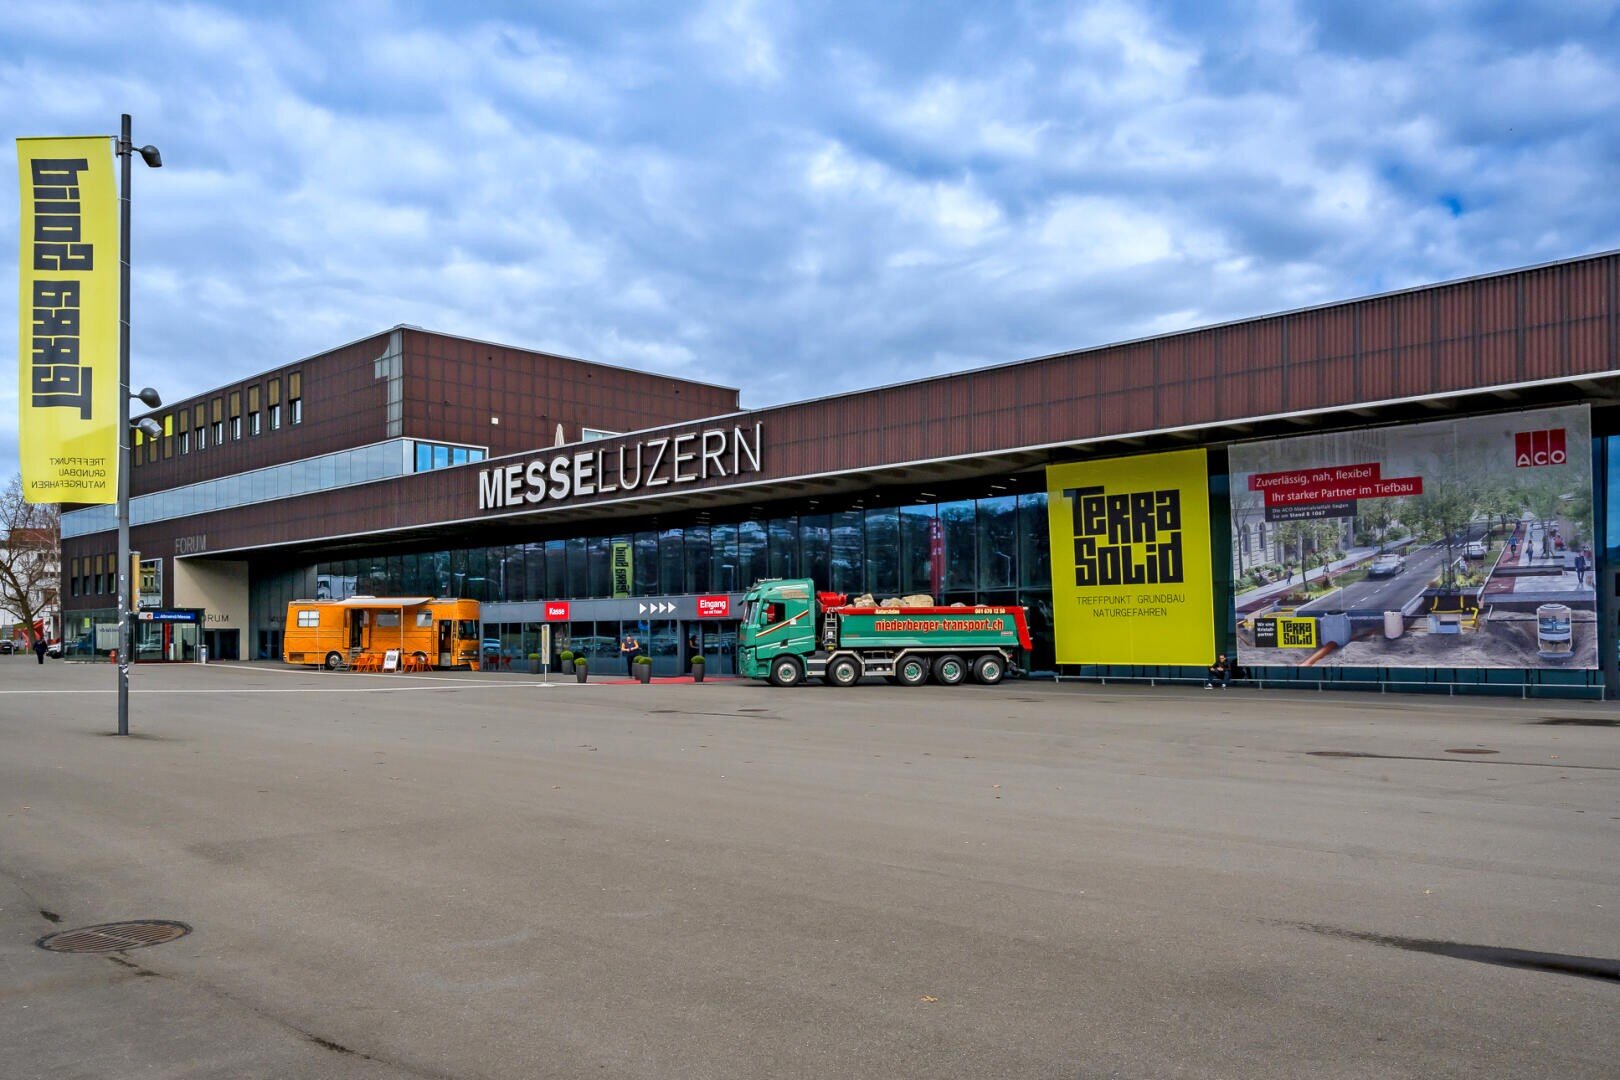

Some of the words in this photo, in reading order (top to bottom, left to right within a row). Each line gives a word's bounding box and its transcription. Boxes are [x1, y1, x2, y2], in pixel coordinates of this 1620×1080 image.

[1517, 450, 1566, 466] ACO
[1256, 474, 1310, 487] Zuverlässig,
[1312, 472, 1333, 482] nah,
[1336, 467, 1372, 480] flexibel
[1272, 493, 1285, 502] Ihr
[1287, 490, 1319, 501] starker
[1321, 488, 1356, 498] Partner
[1359, 485, 1372, 495] im
[1374, 483, 1414, 493] Tiefbau
[175, 534, 206, 554] FORUM
[699, 599, 727, 610] Eingang
[1076, 595, 1131, 606] TREFFPUNKT
[1137, 593, 1185, 604] GRUNDBAU
[548, 607, 565, 616] Kasse
[1092, 607, 1167, 617] NATURGEFAHREN
[874, 618, 1004, 632] niederberger-transport.ch
